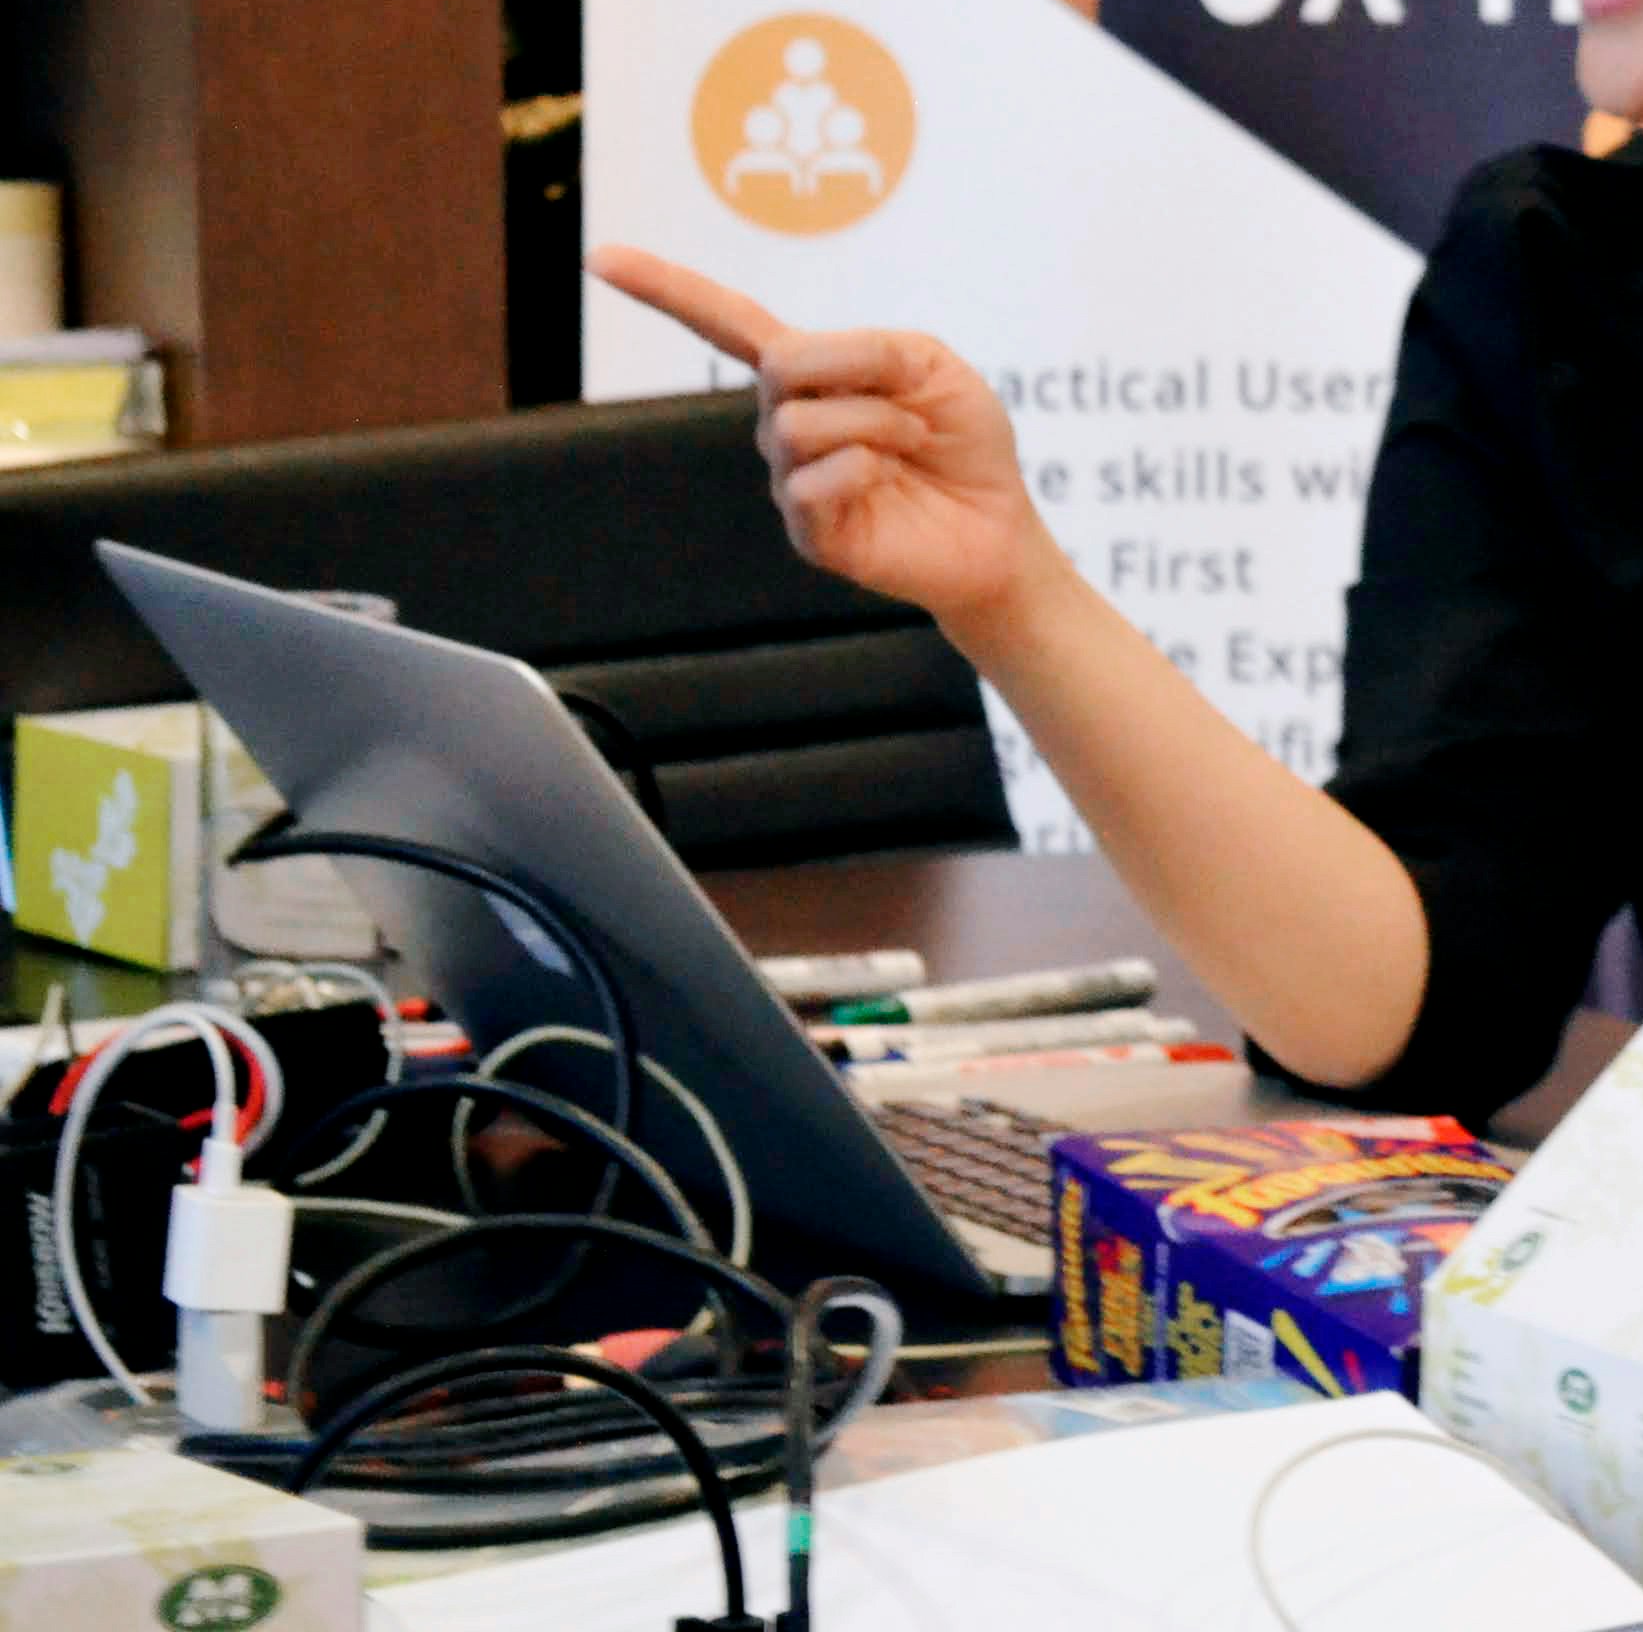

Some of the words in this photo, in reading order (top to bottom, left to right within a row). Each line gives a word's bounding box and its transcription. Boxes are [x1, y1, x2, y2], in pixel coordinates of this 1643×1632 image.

[1000, 358, 1209, 412] actical
[1100, 452, 1264, 502] skills
[1293, 455, 1367, 502] wi
[1110, 542, 1254, 593] First
[1227, 632, 1344, 696] Exp
